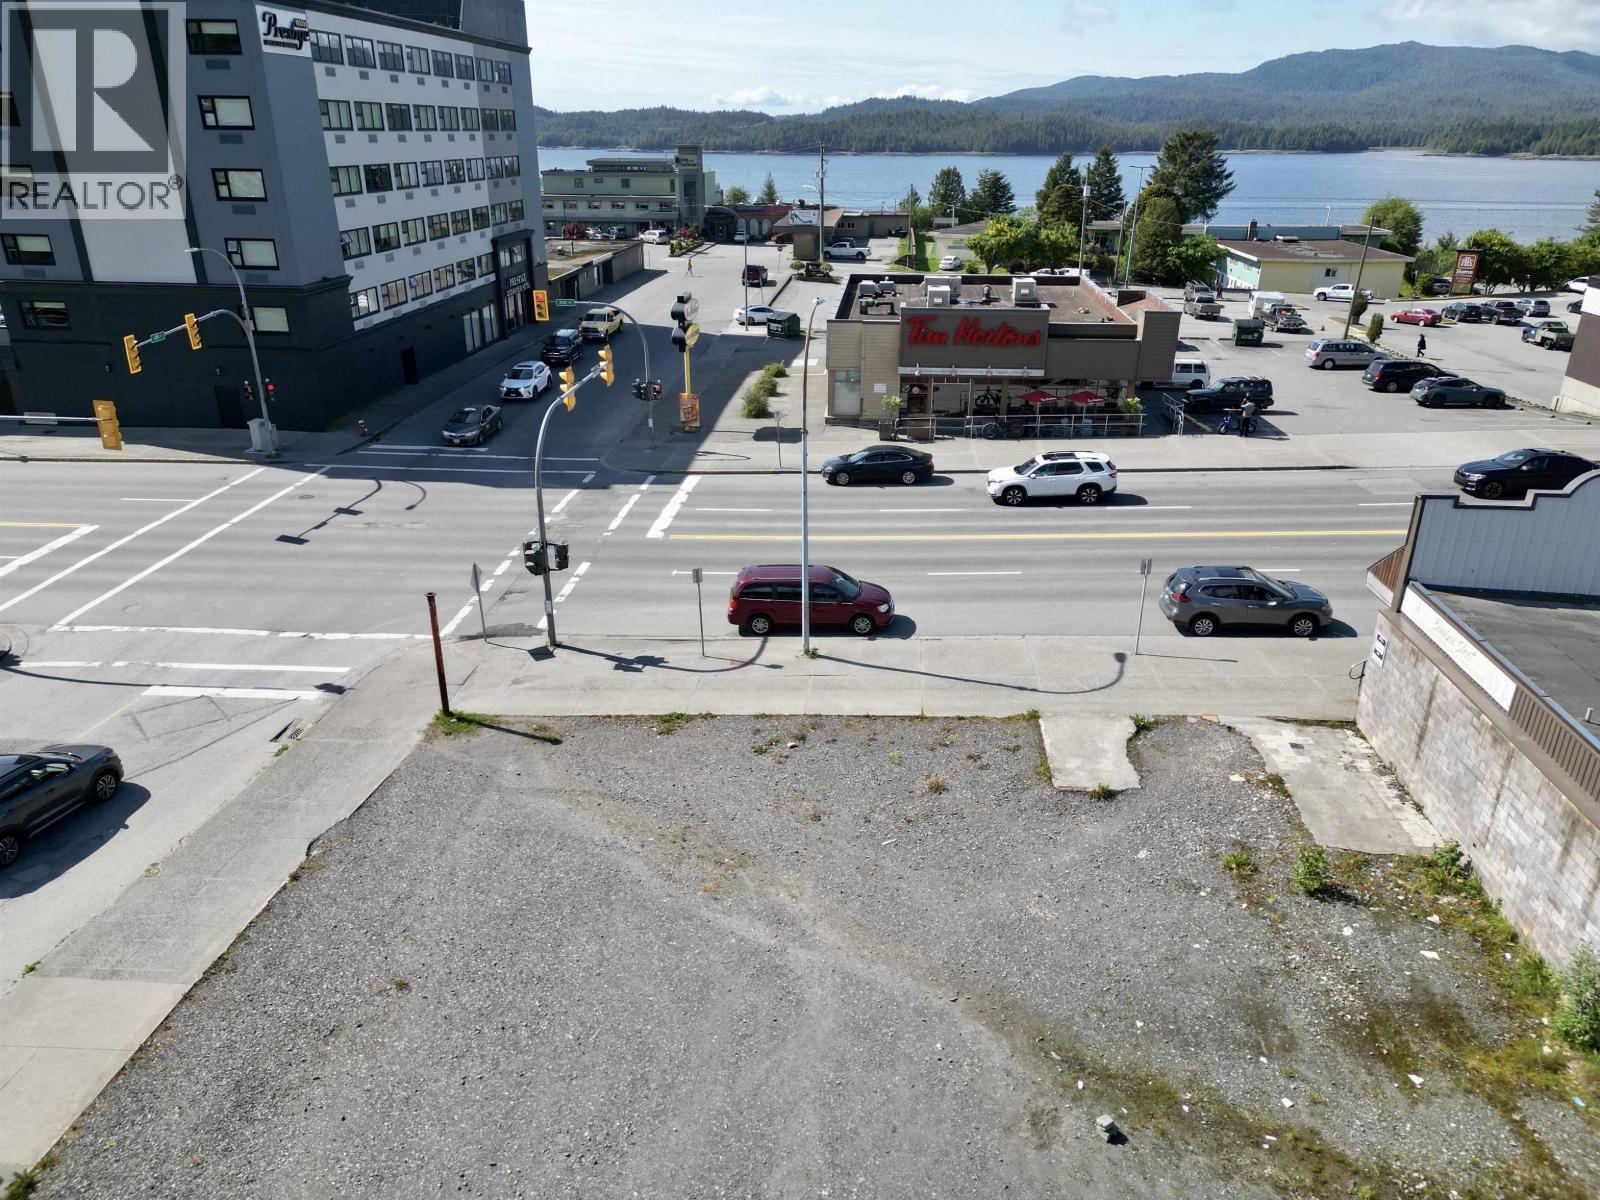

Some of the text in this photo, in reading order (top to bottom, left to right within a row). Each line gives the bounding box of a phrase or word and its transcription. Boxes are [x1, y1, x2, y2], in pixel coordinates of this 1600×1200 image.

[262, 11, 310, 50] Prestige
[906, 315, 1042, 348] Tim Hortons
